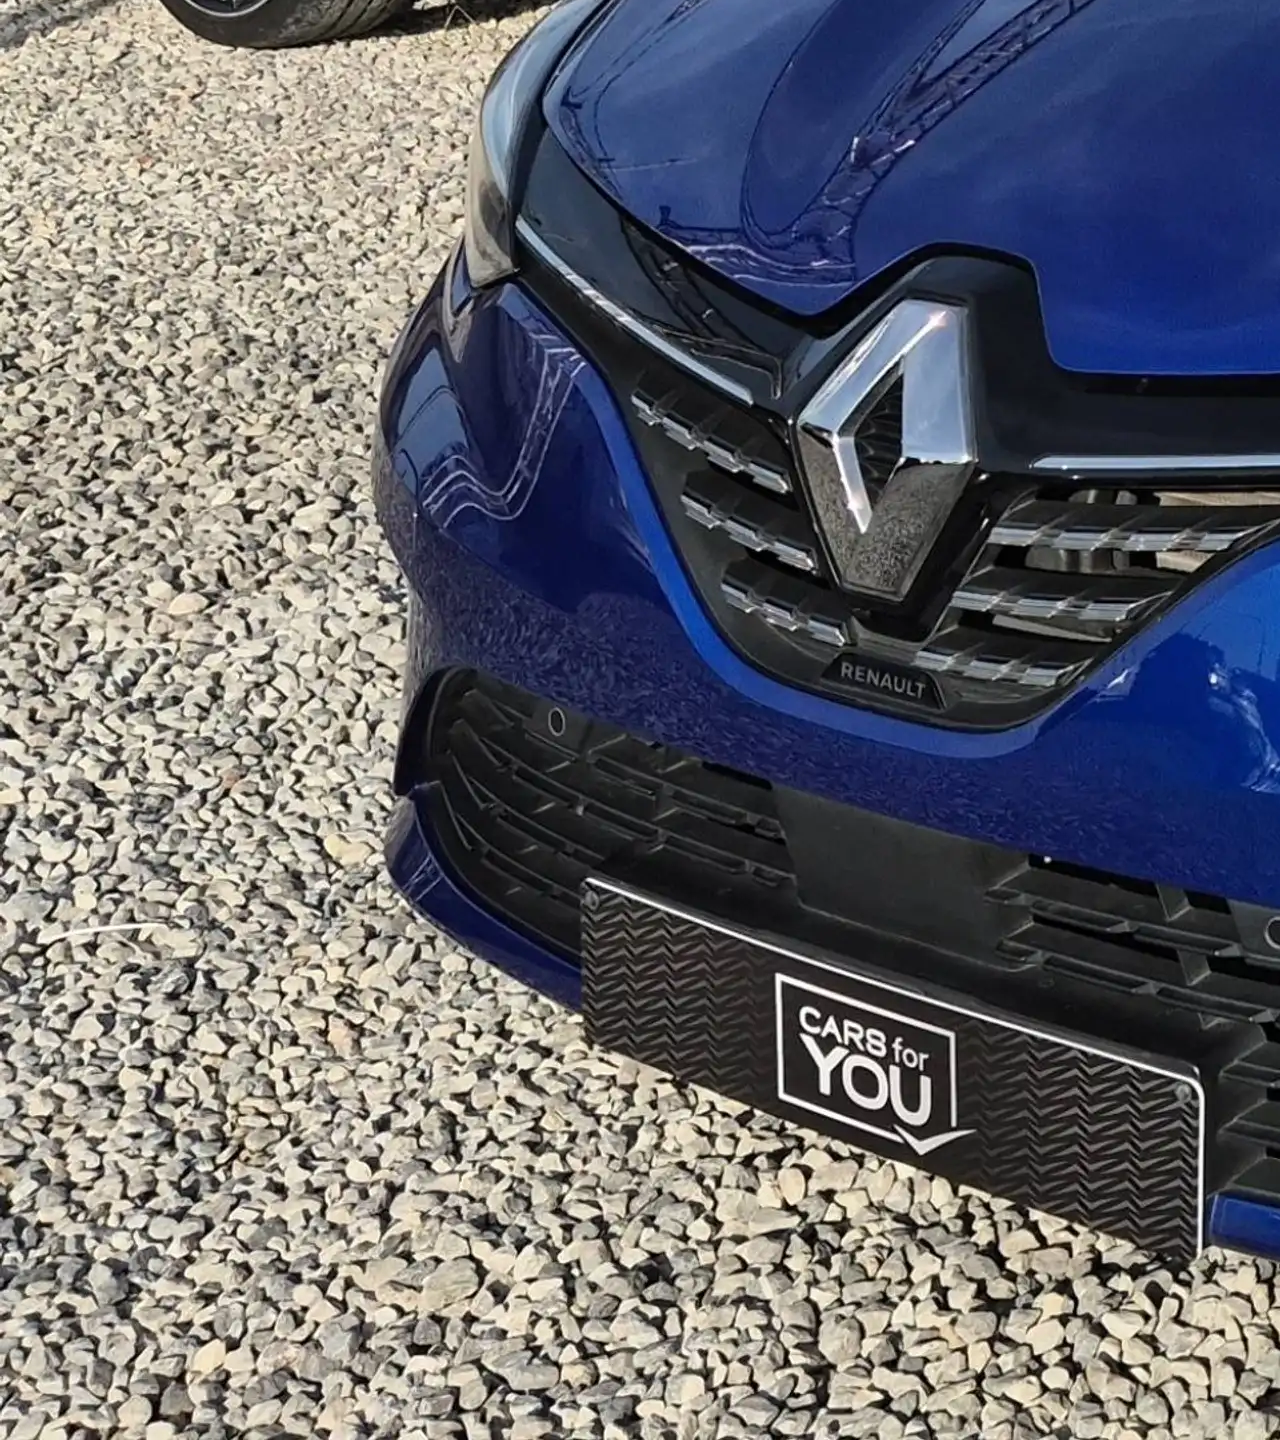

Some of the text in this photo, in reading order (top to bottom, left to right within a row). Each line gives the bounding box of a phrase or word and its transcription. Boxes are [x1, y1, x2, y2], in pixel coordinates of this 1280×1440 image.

[841, 663, 926, 700] RENAULT
[799, 1006, 929, 1072] CARS for
[799, 1033, 932, 1126] YOU
